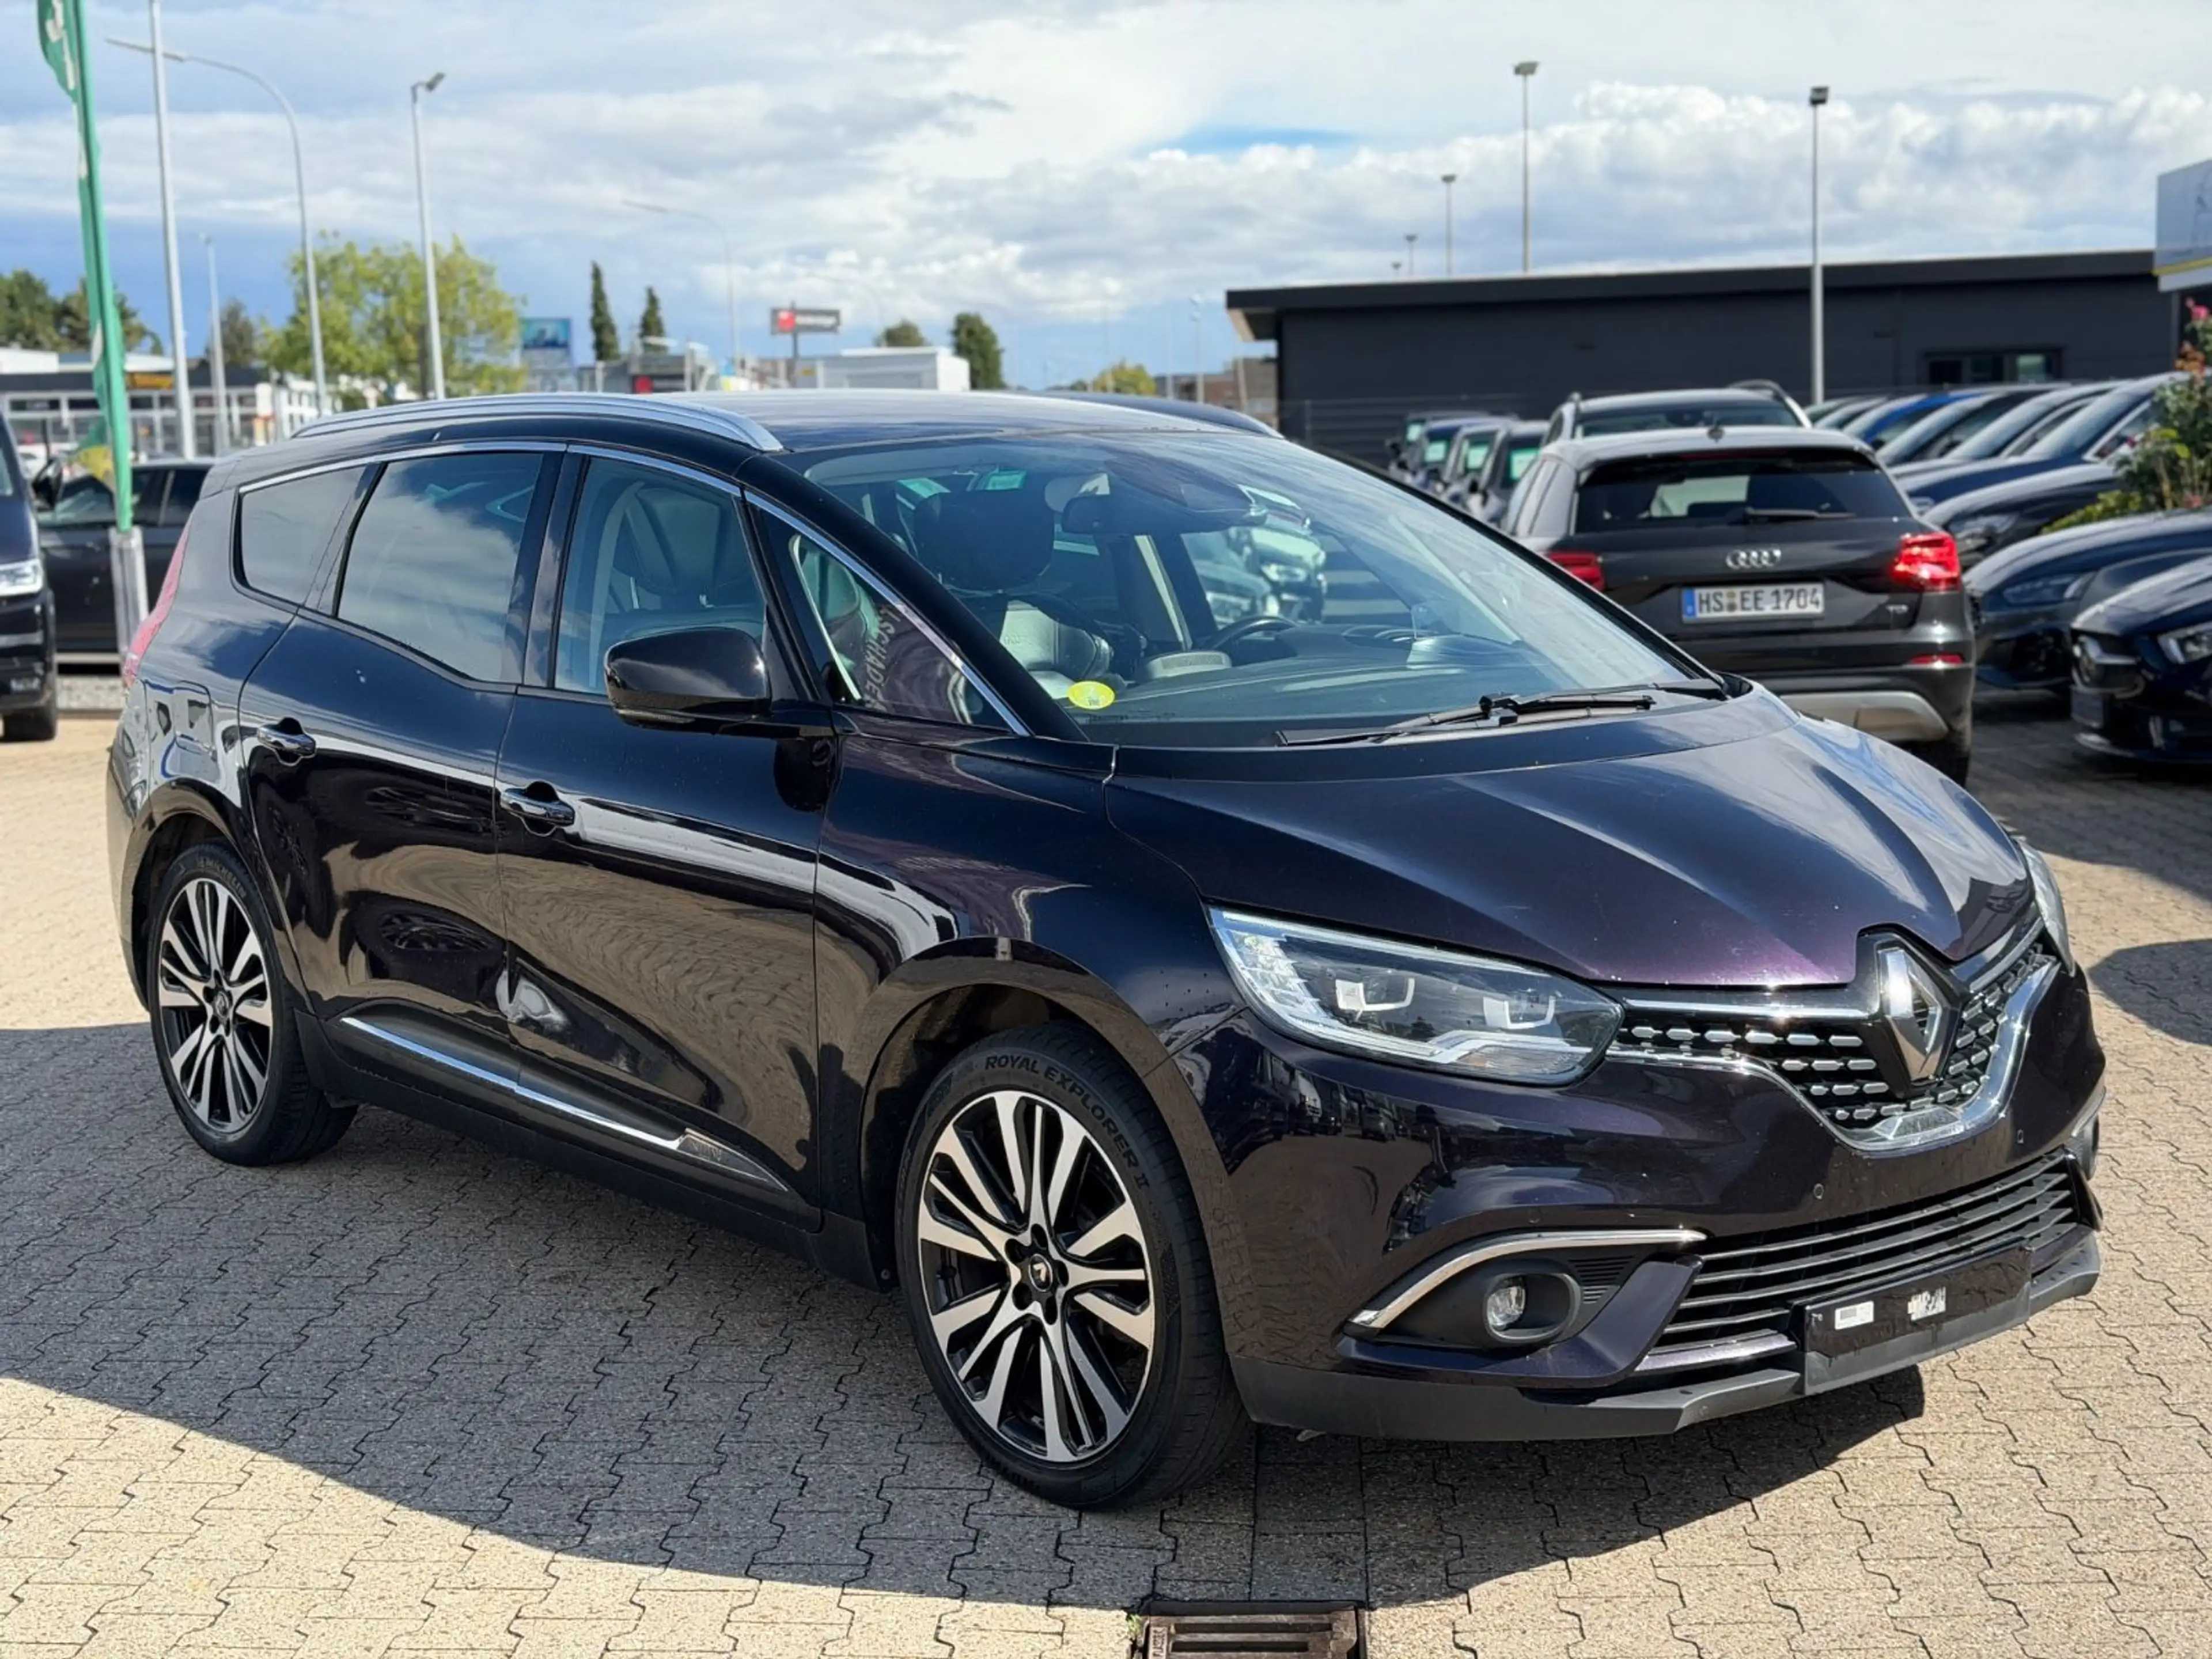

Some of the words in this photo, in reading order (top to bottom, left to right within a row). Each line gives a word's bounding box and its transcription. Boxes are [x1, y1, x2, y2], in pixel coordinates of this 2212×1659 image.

[1698, 592, 1724, 613] HS
[1740, 590, 1765, 611] EE
[1770, 588, 1820, 610] 1704
[984, 1055, 1040, 1074] ROYAL
[1043, 1066, 1139, 1168] EXPLORER
[1134, 1172, 1150, 1190] II
